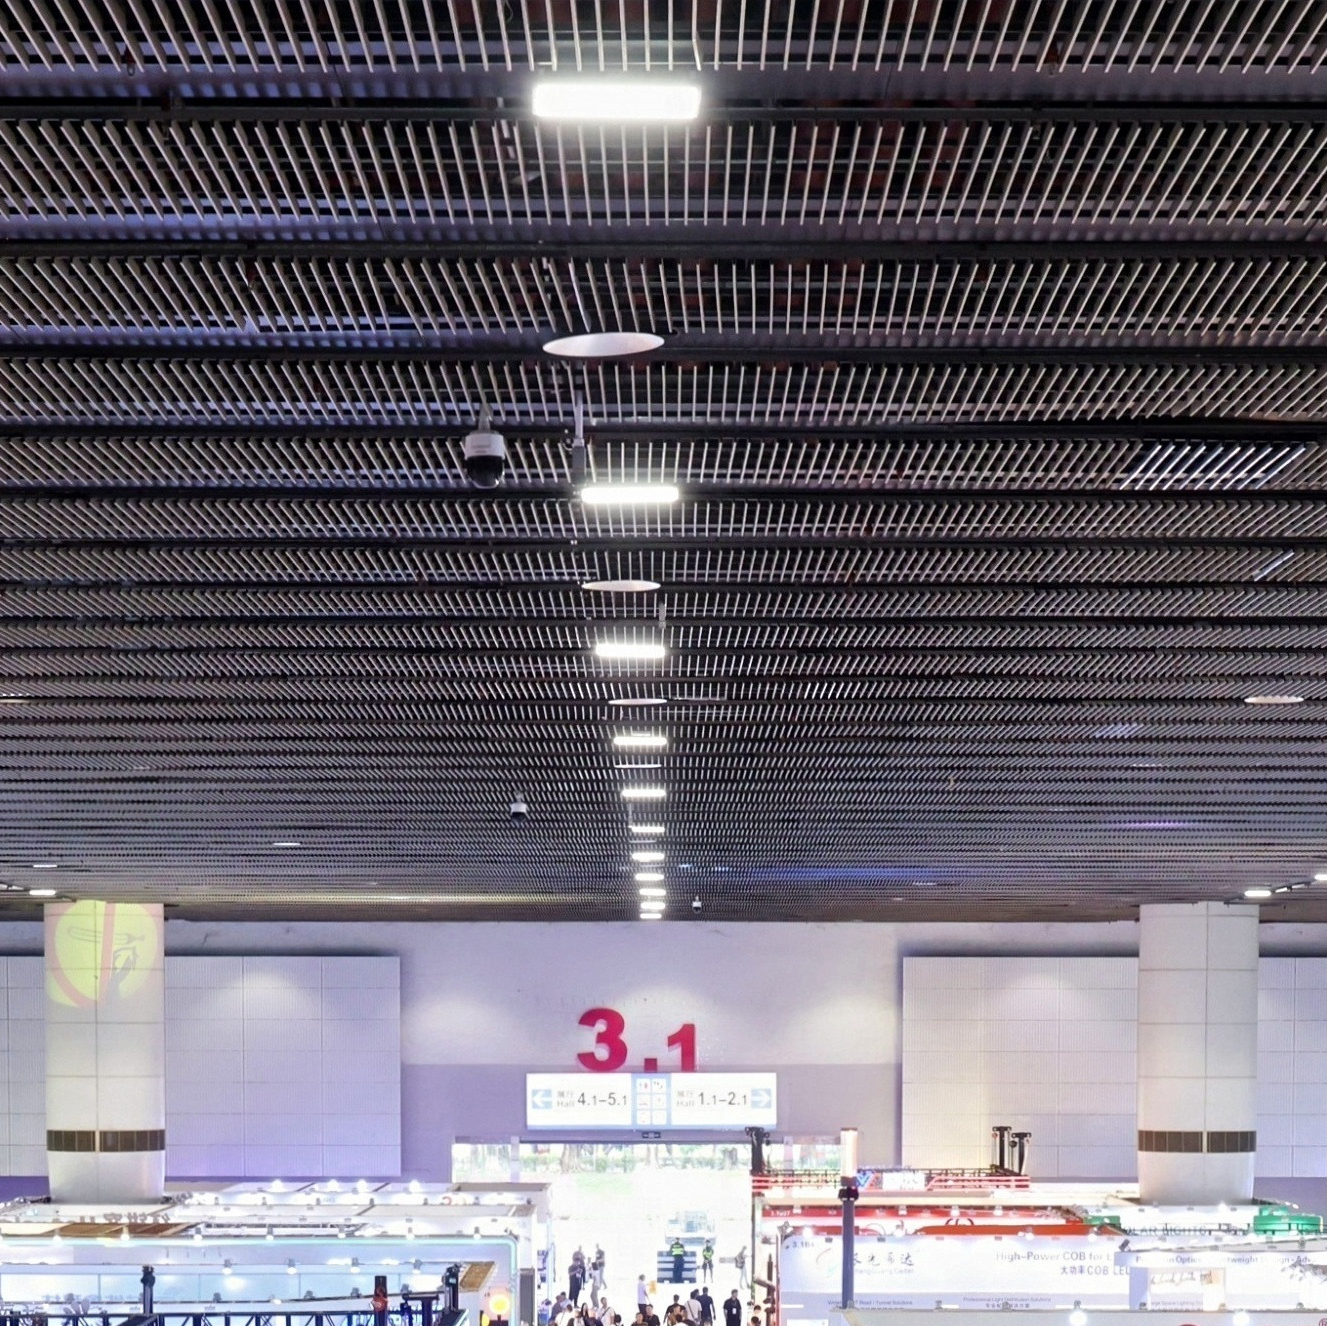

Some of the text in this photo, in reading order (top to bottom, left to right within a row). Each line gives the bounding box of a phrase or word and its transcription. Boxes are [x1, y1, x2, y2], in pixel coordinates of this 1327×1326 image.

[577, 1008, 698, 1072] 3.1
[996, 1251, 1060, 1263] High-Power
[1062, 1251, 1086, 1261] COB
